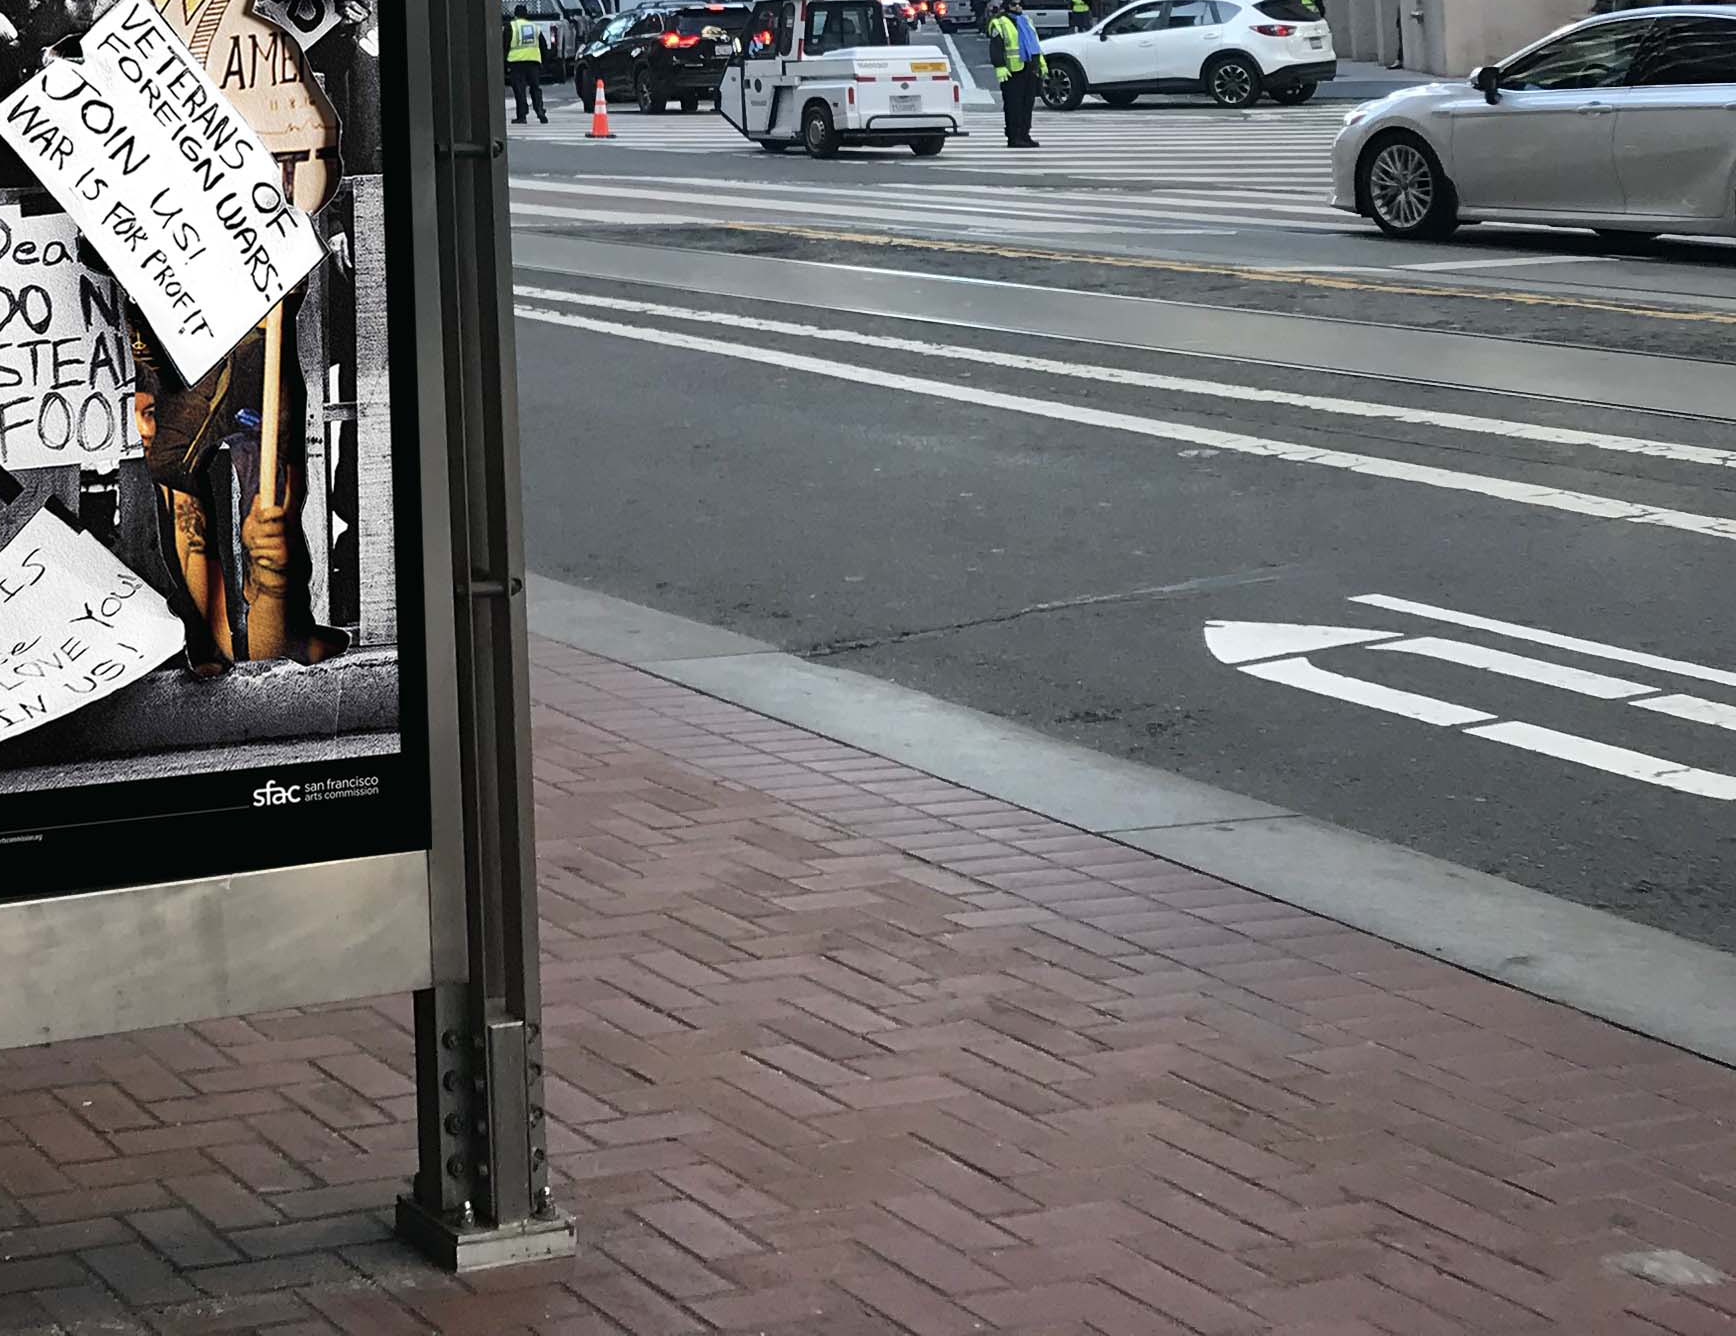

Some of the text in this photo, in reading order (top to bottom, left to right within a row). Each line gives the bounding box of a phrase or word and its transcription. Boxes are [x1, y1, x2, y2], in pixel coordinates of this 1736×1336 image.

[220, 31, 305, 90] AME
[97, 33, 224, 192] FOREIGN
[121, 4, 298, 238] VETERANS OF
[42, 69, 206, 265] JOIN US!
[7, 94, 215, 338] WAR IS FOR PROFIT
[64, 642, 145, 695] US!
[253, 779, 301, 807] sfac
[304, 776, 379, 793] san francisco
[304, 786, 379, 802] arts commission
